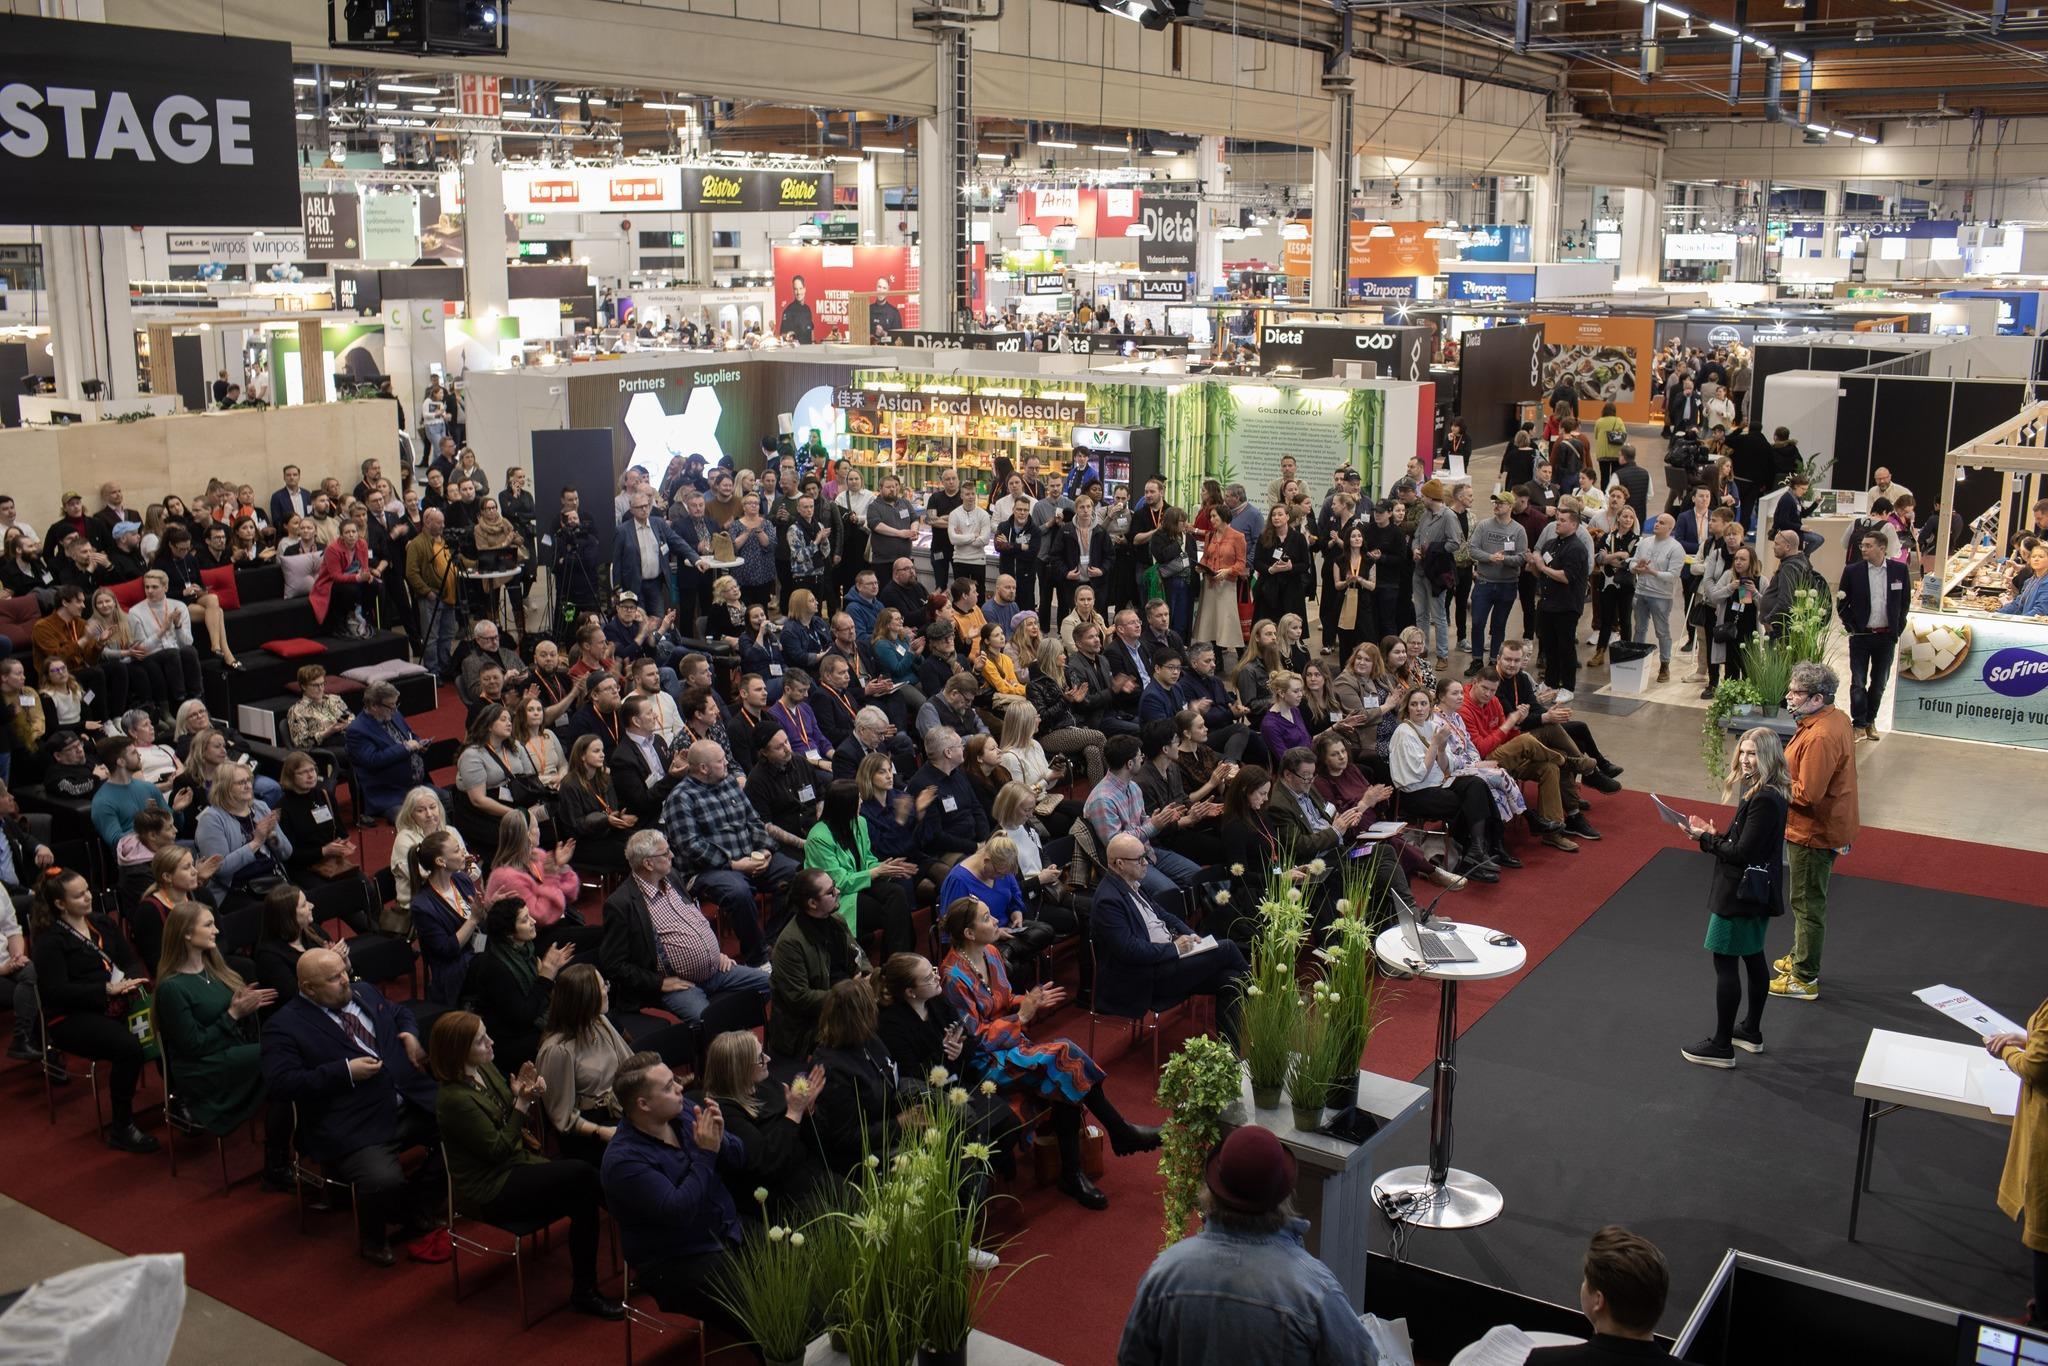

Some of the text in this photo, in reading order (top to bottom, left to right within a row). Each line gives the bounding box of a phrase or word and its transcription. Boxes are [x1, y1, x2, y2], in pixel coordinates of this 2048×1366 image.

[376, 12, 385, 24] 12
[0, 83, 254, 165] STAGE
[307, 197, 335, 216] ARLA
[308, 216, 334, 235] PRO.
[212, 239, 246, 259] winpos
[252, 239, 300, 260] winpos
[341, 280, 357, 294] ARLA
[1038, 275, 1063, 287] LAATU
[1144, 282, 1183, 292] LAATU
[1363, 282, 1411, 298] Pinpops
[1265, 329, 1303, 345] Dieta
[1465, 333, 1481, 347] Dieta
[618, 370, 741, 392] Partners Suppliers
[837, 391, 864, 408] 佳禾
[876, 394, 1079, 420] Asian Food Wholesaler
[1989, 660, 2048, 682] SoFine
[1918, 697, 1952, 714] Tofun
[1956, 702, 2025, 725] pioneereja
